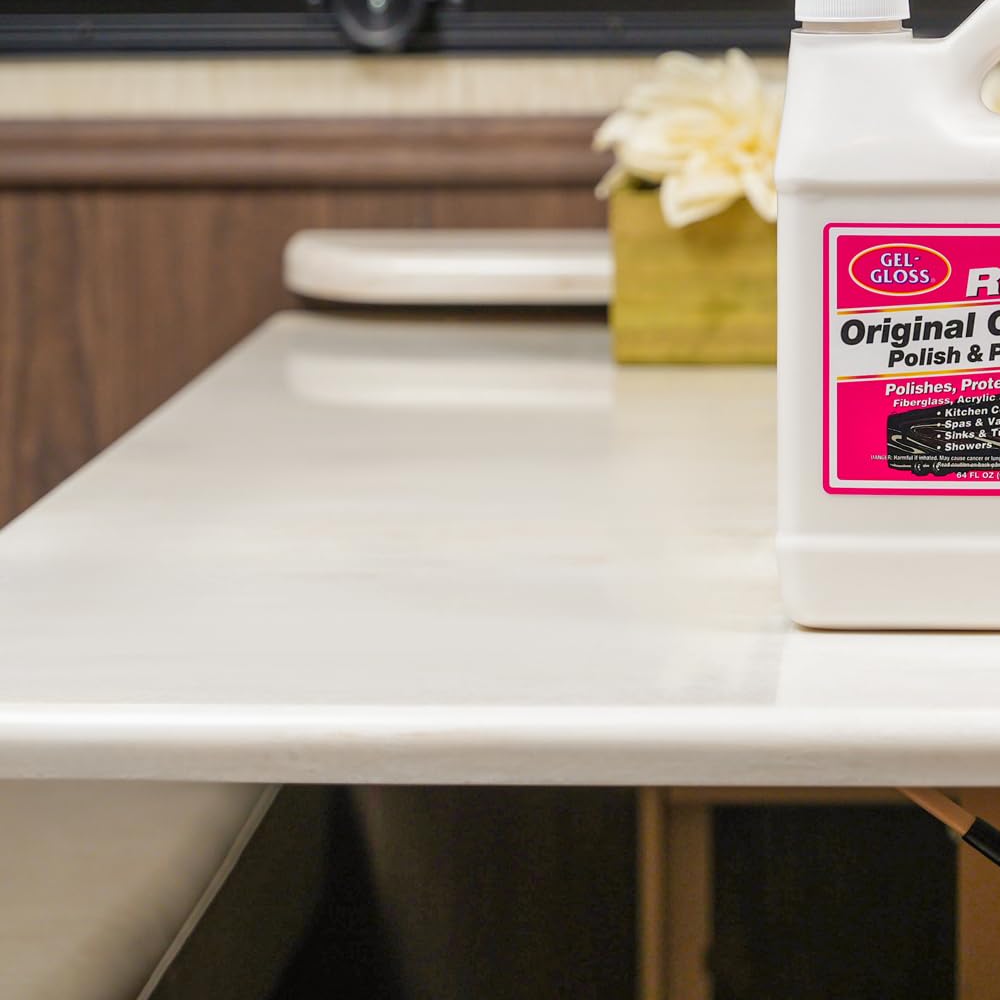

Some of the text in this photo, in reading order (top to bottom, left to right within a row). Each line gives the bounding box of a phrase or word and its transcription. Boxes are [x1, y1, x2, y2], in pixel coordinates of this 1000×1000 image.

[880, 253, 919, 267] GEL-
[870, 269, 930, 284] GLOSS
[841, 312, 976, 346] Original
[888, 347, 961, 367] Polish
[967, 345, 983, 362] &
[885, 381, 957, 396] Polishes,
[893, 397, 953, 407] Fiberglass,
[957, 393, 995, 404] Acrylic
[945, 405, 988, 416] Kitchen
[944, 418, 971, 430] Spas
[975, 418, 983, 426] &
[944, 430, 975, 440] Sinks
[978, 429, 986, 438] &
[944, 441, 992, 451] Showers
